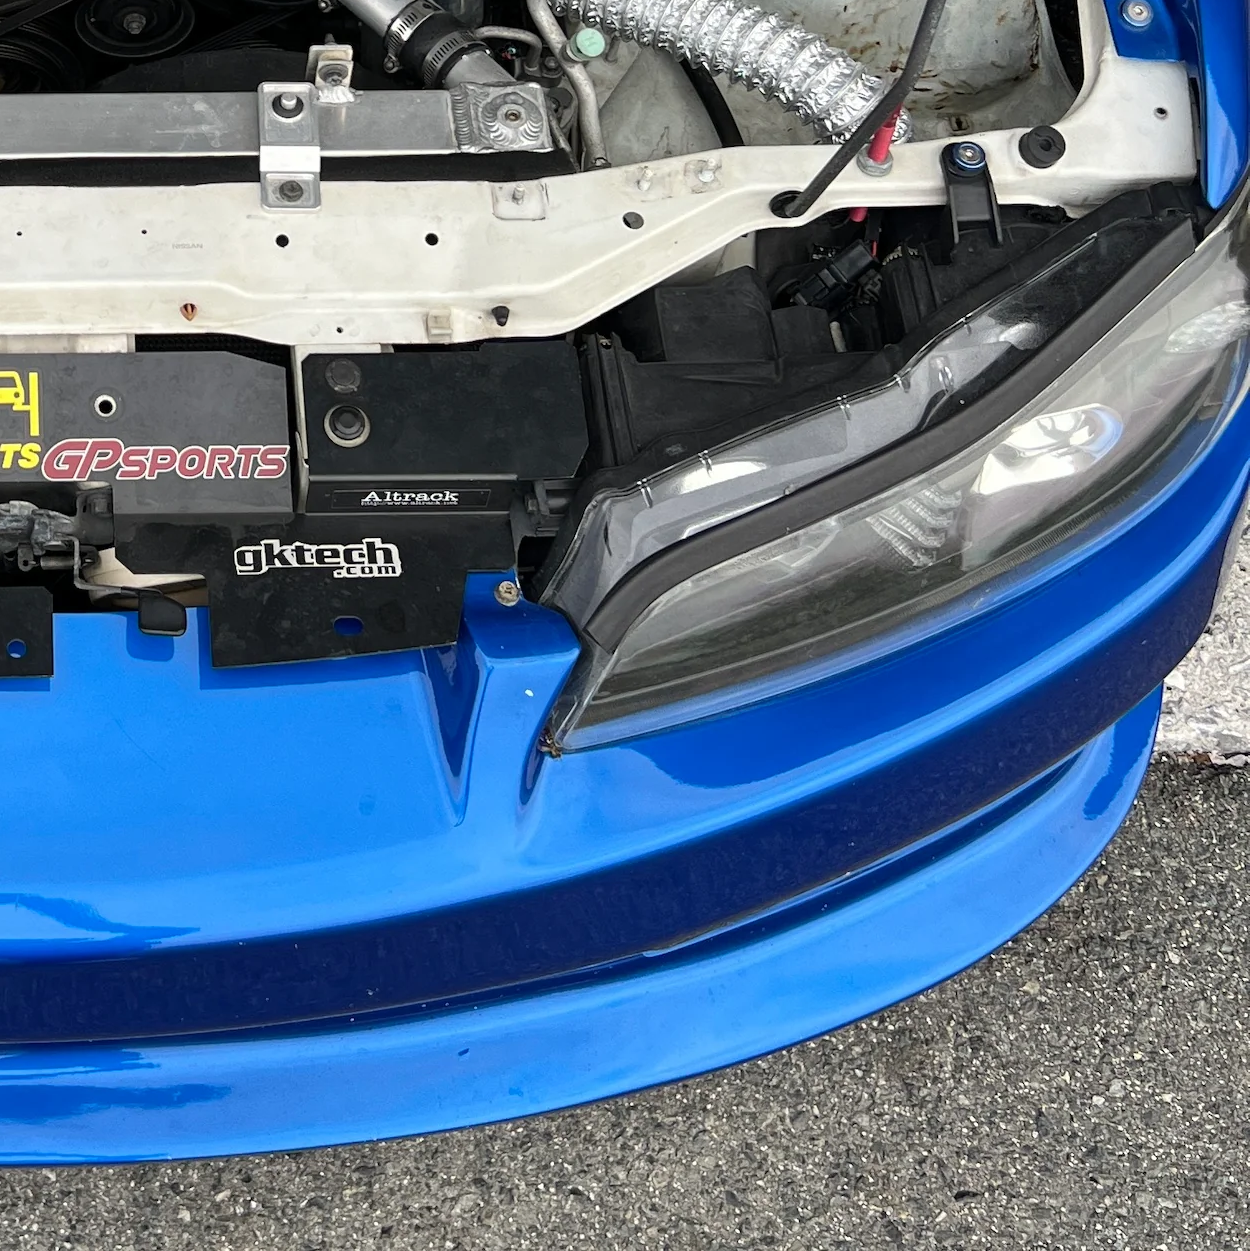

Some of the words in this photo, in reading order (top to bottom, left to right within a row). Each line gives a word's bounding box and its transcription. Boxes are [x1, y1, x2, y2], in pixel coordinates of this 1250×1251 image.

[361, 491, 459, 502] Altrack
[235, 539, 401, 575] gktech
[333, 564, 401, 578] .com
